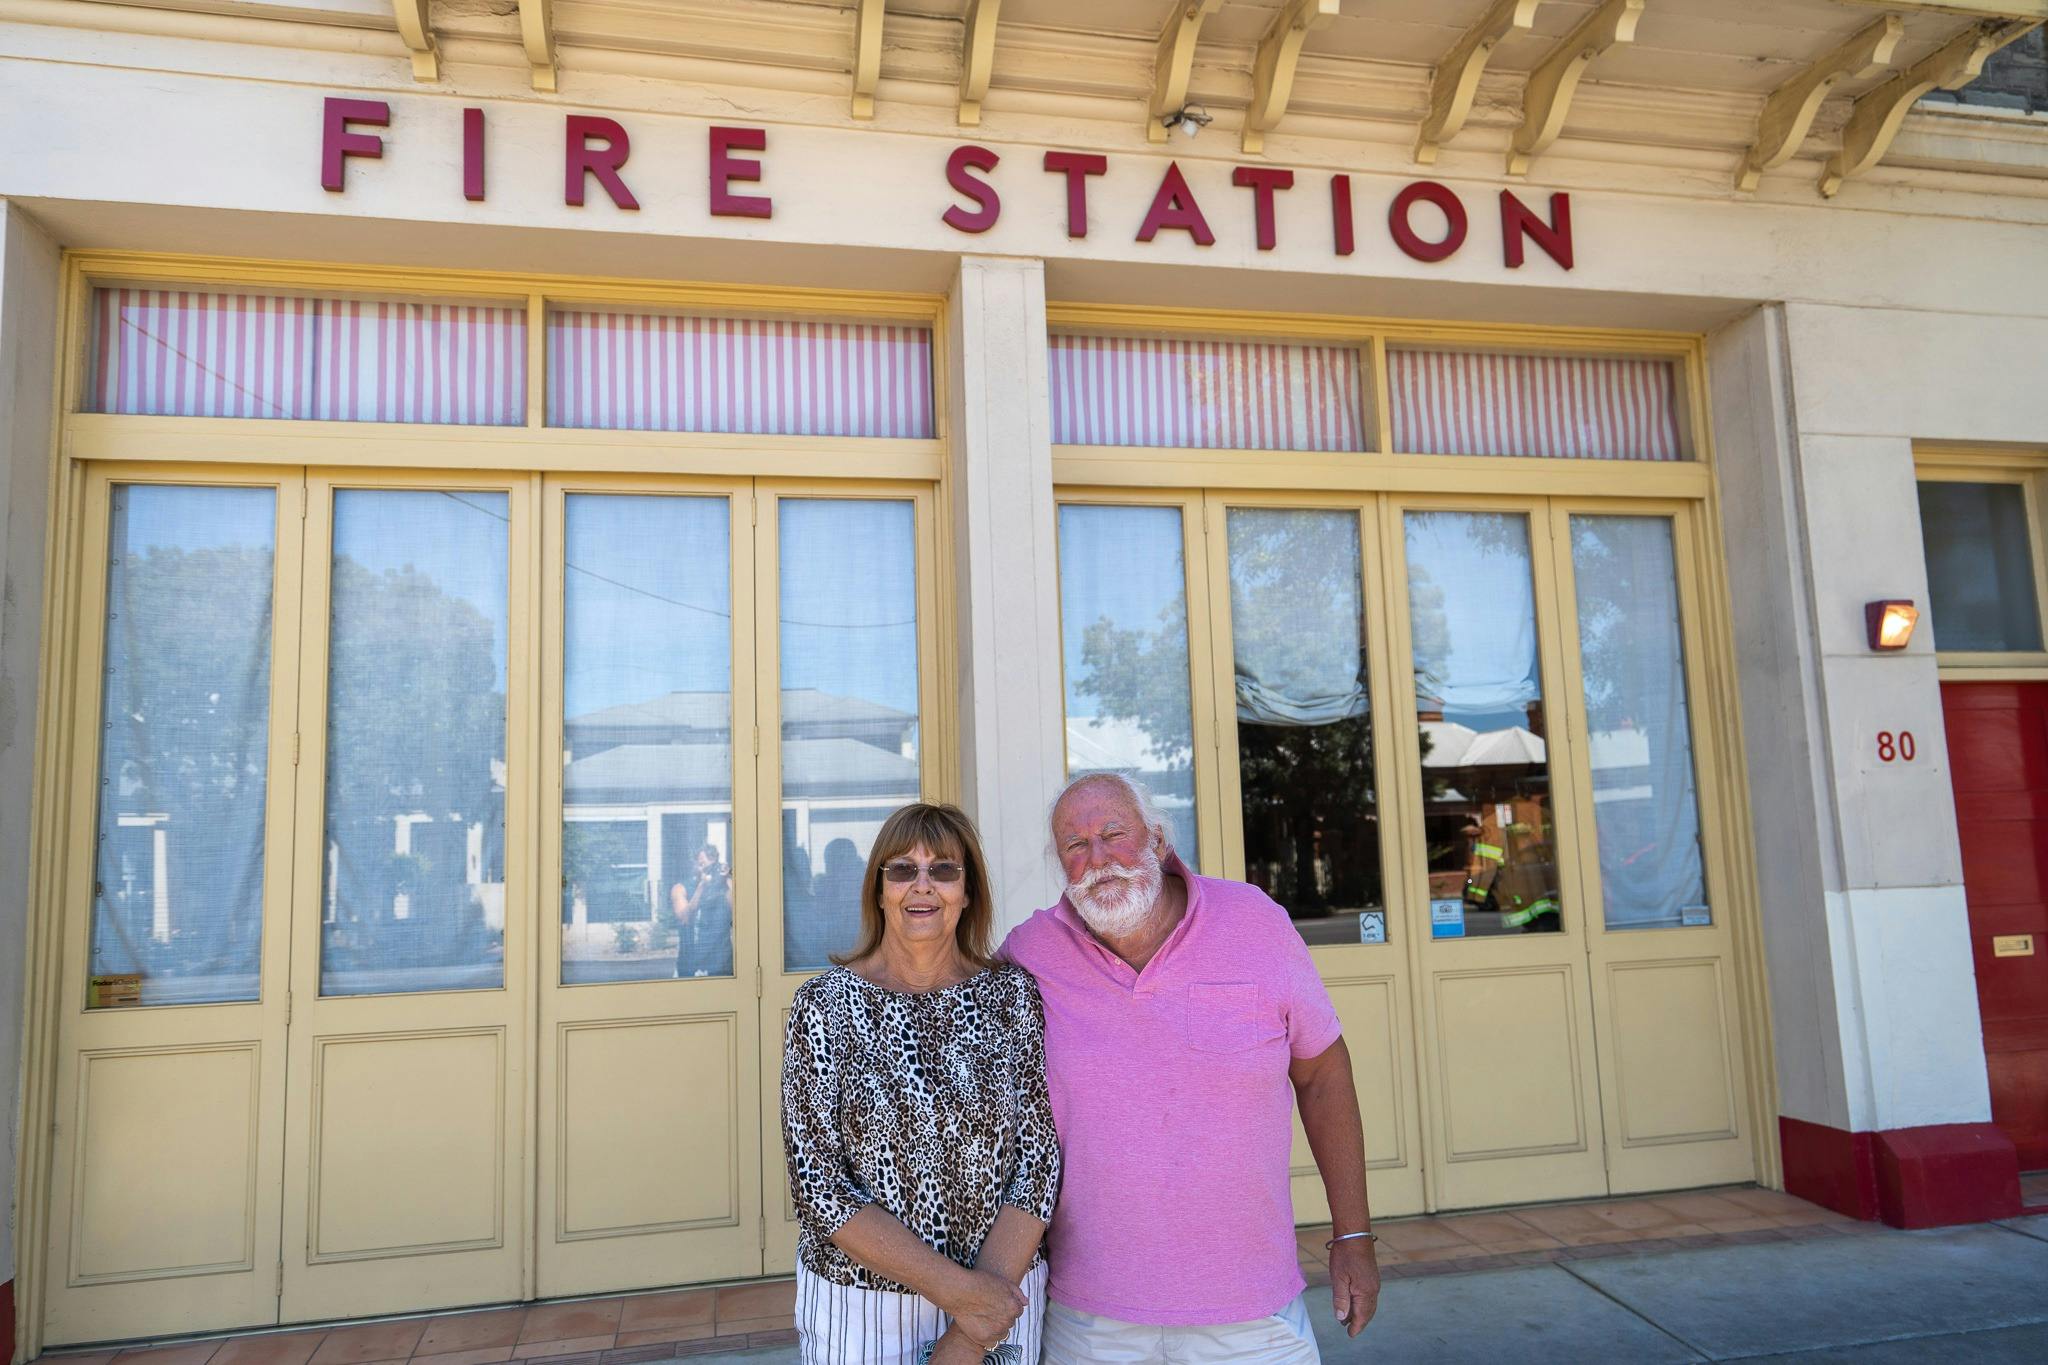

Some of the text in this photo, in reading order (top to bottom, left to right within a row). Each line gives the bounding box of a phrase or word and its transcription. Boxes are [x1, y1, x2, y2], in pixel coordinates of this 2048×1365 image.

[322, 97, 1575, 271] FIRE STATION
[1877, 731, 1915, 762] 80
